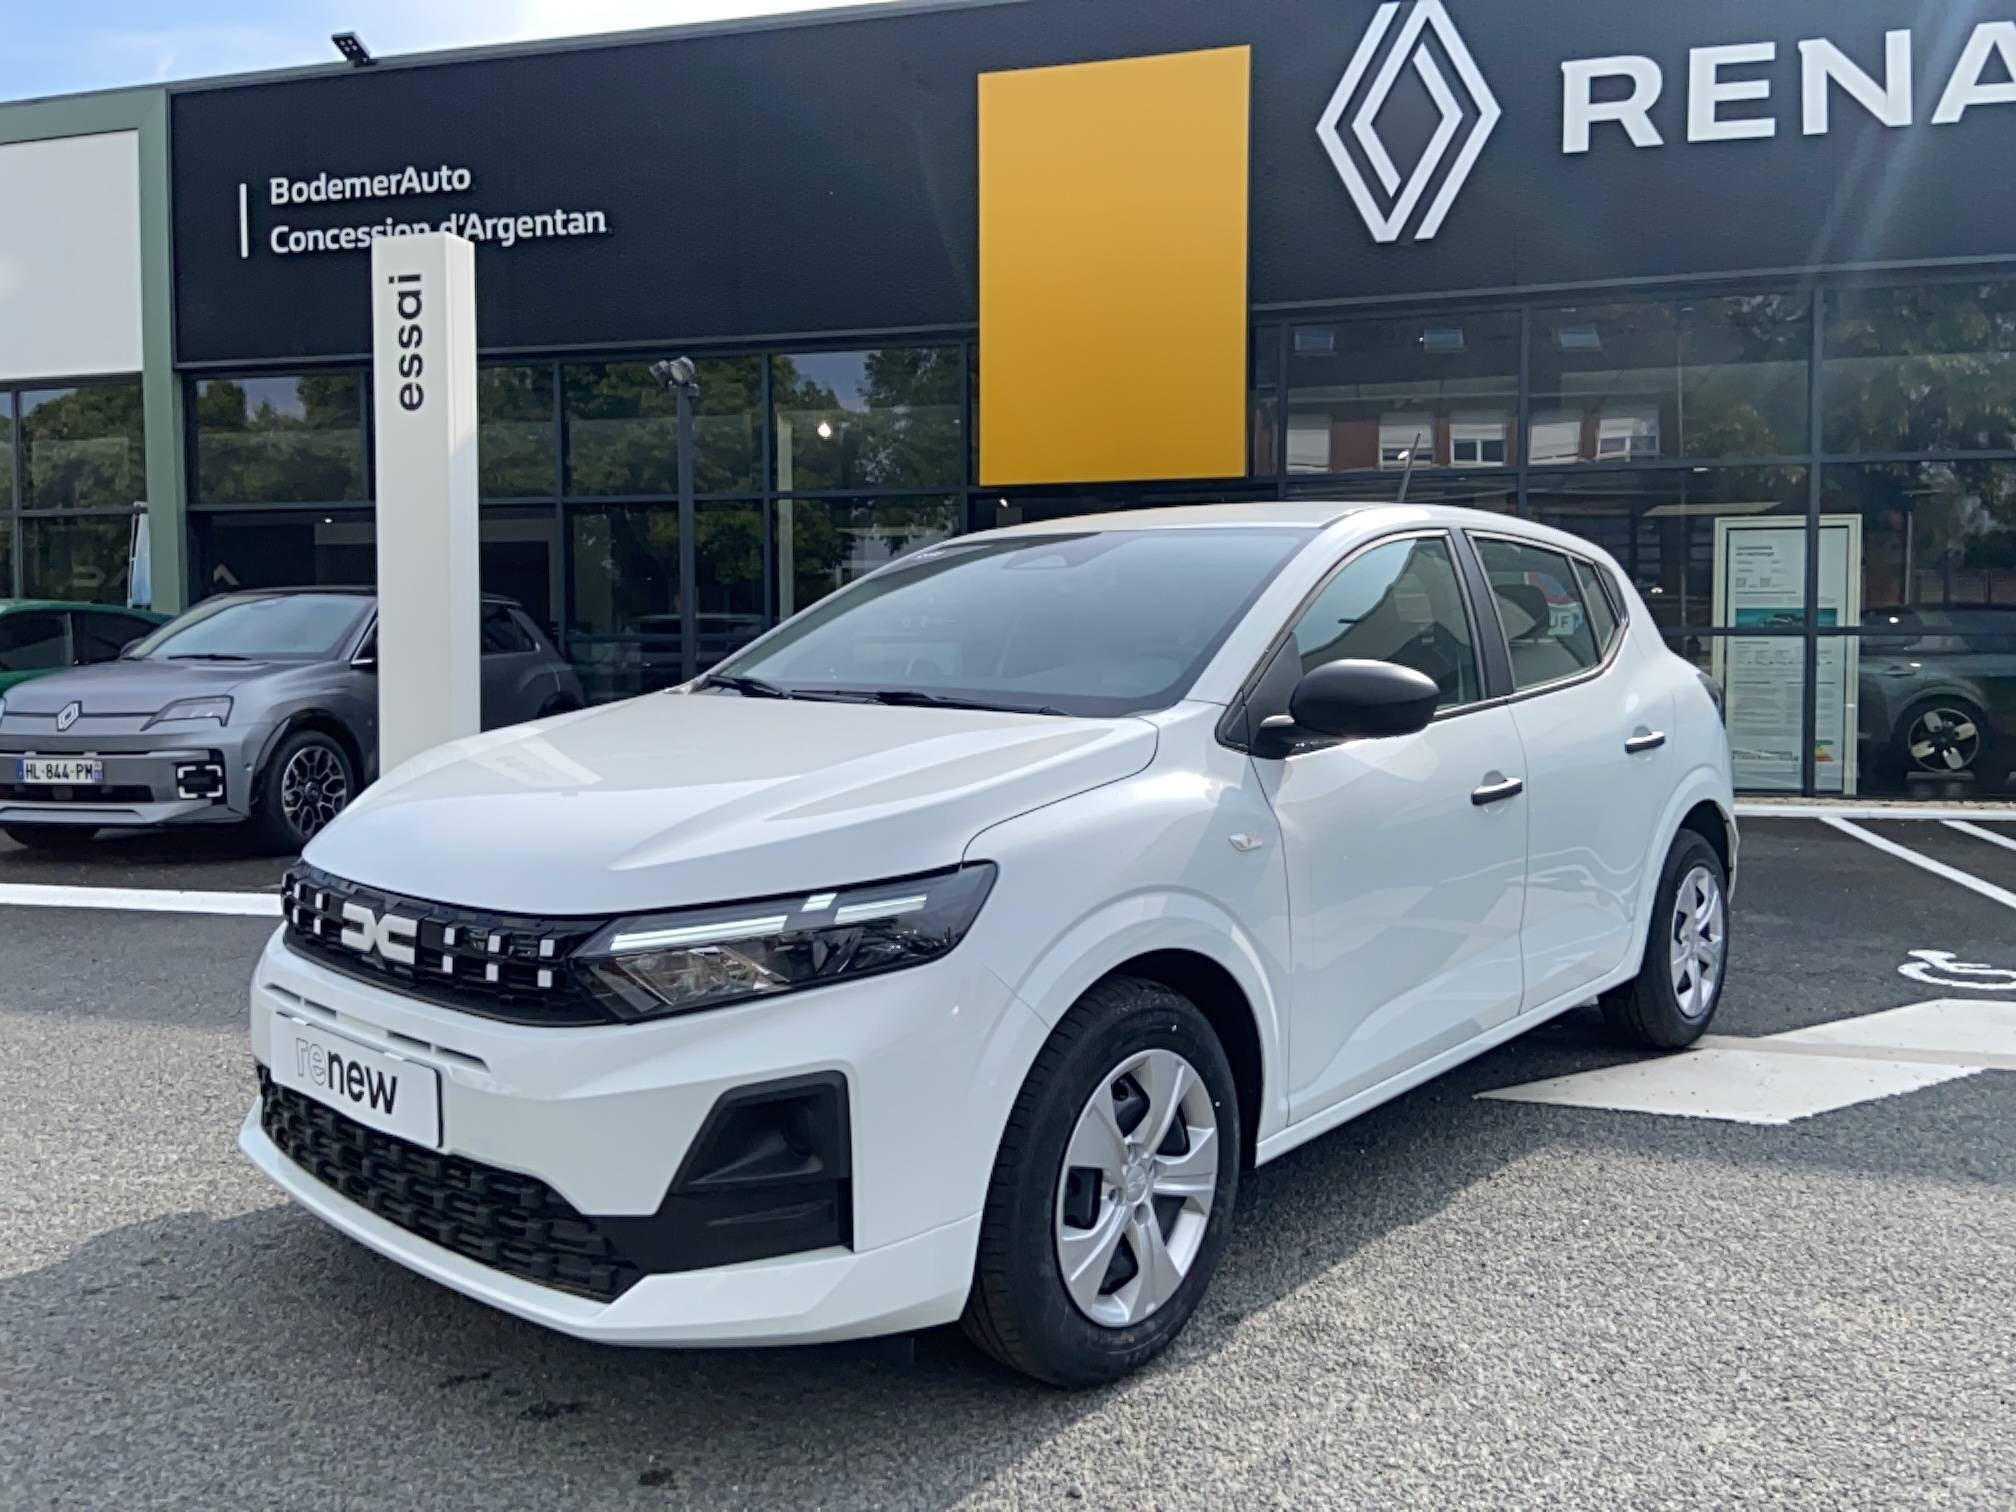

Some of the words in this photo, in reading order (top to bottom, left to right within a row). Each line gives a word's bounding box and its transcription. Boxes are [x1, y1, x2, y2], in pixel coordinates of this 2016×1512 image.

[270, 165, 472, 205] BodemerAuto
[438, 209, 606, 246] d'Argentan
[388, 272, 424, 411] essai
[295, 1036, 399, 1115] renew
